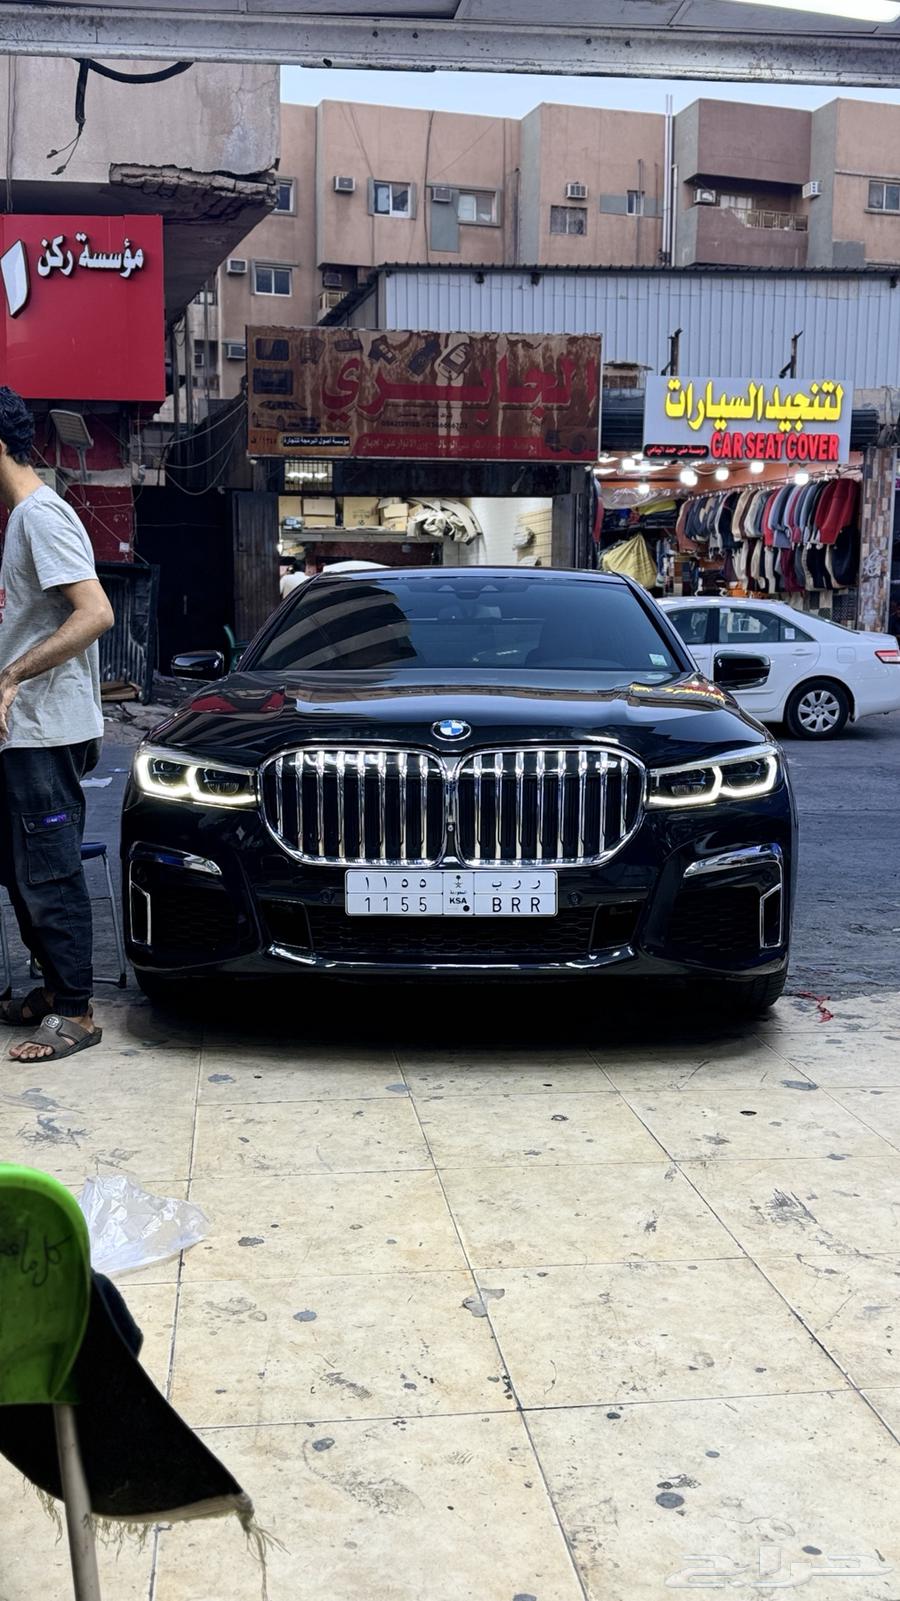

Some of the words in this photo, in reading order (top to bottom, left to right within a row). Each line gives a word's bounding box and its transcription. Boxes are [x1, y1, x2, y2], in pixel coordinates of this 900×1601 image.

[37, 234, 74, 277] ركن
[75, 232, 145, 278] مؤسسة
[665, 378, 764, 431] السيارات
[764, 380, 845, 432] لتنجيد
[710, 431, 744, 459] CAR
[745, 432, 786, 460] SEAT
[786, 433, 840, 462] COVER
[449, 897, 467, 905] KSA
